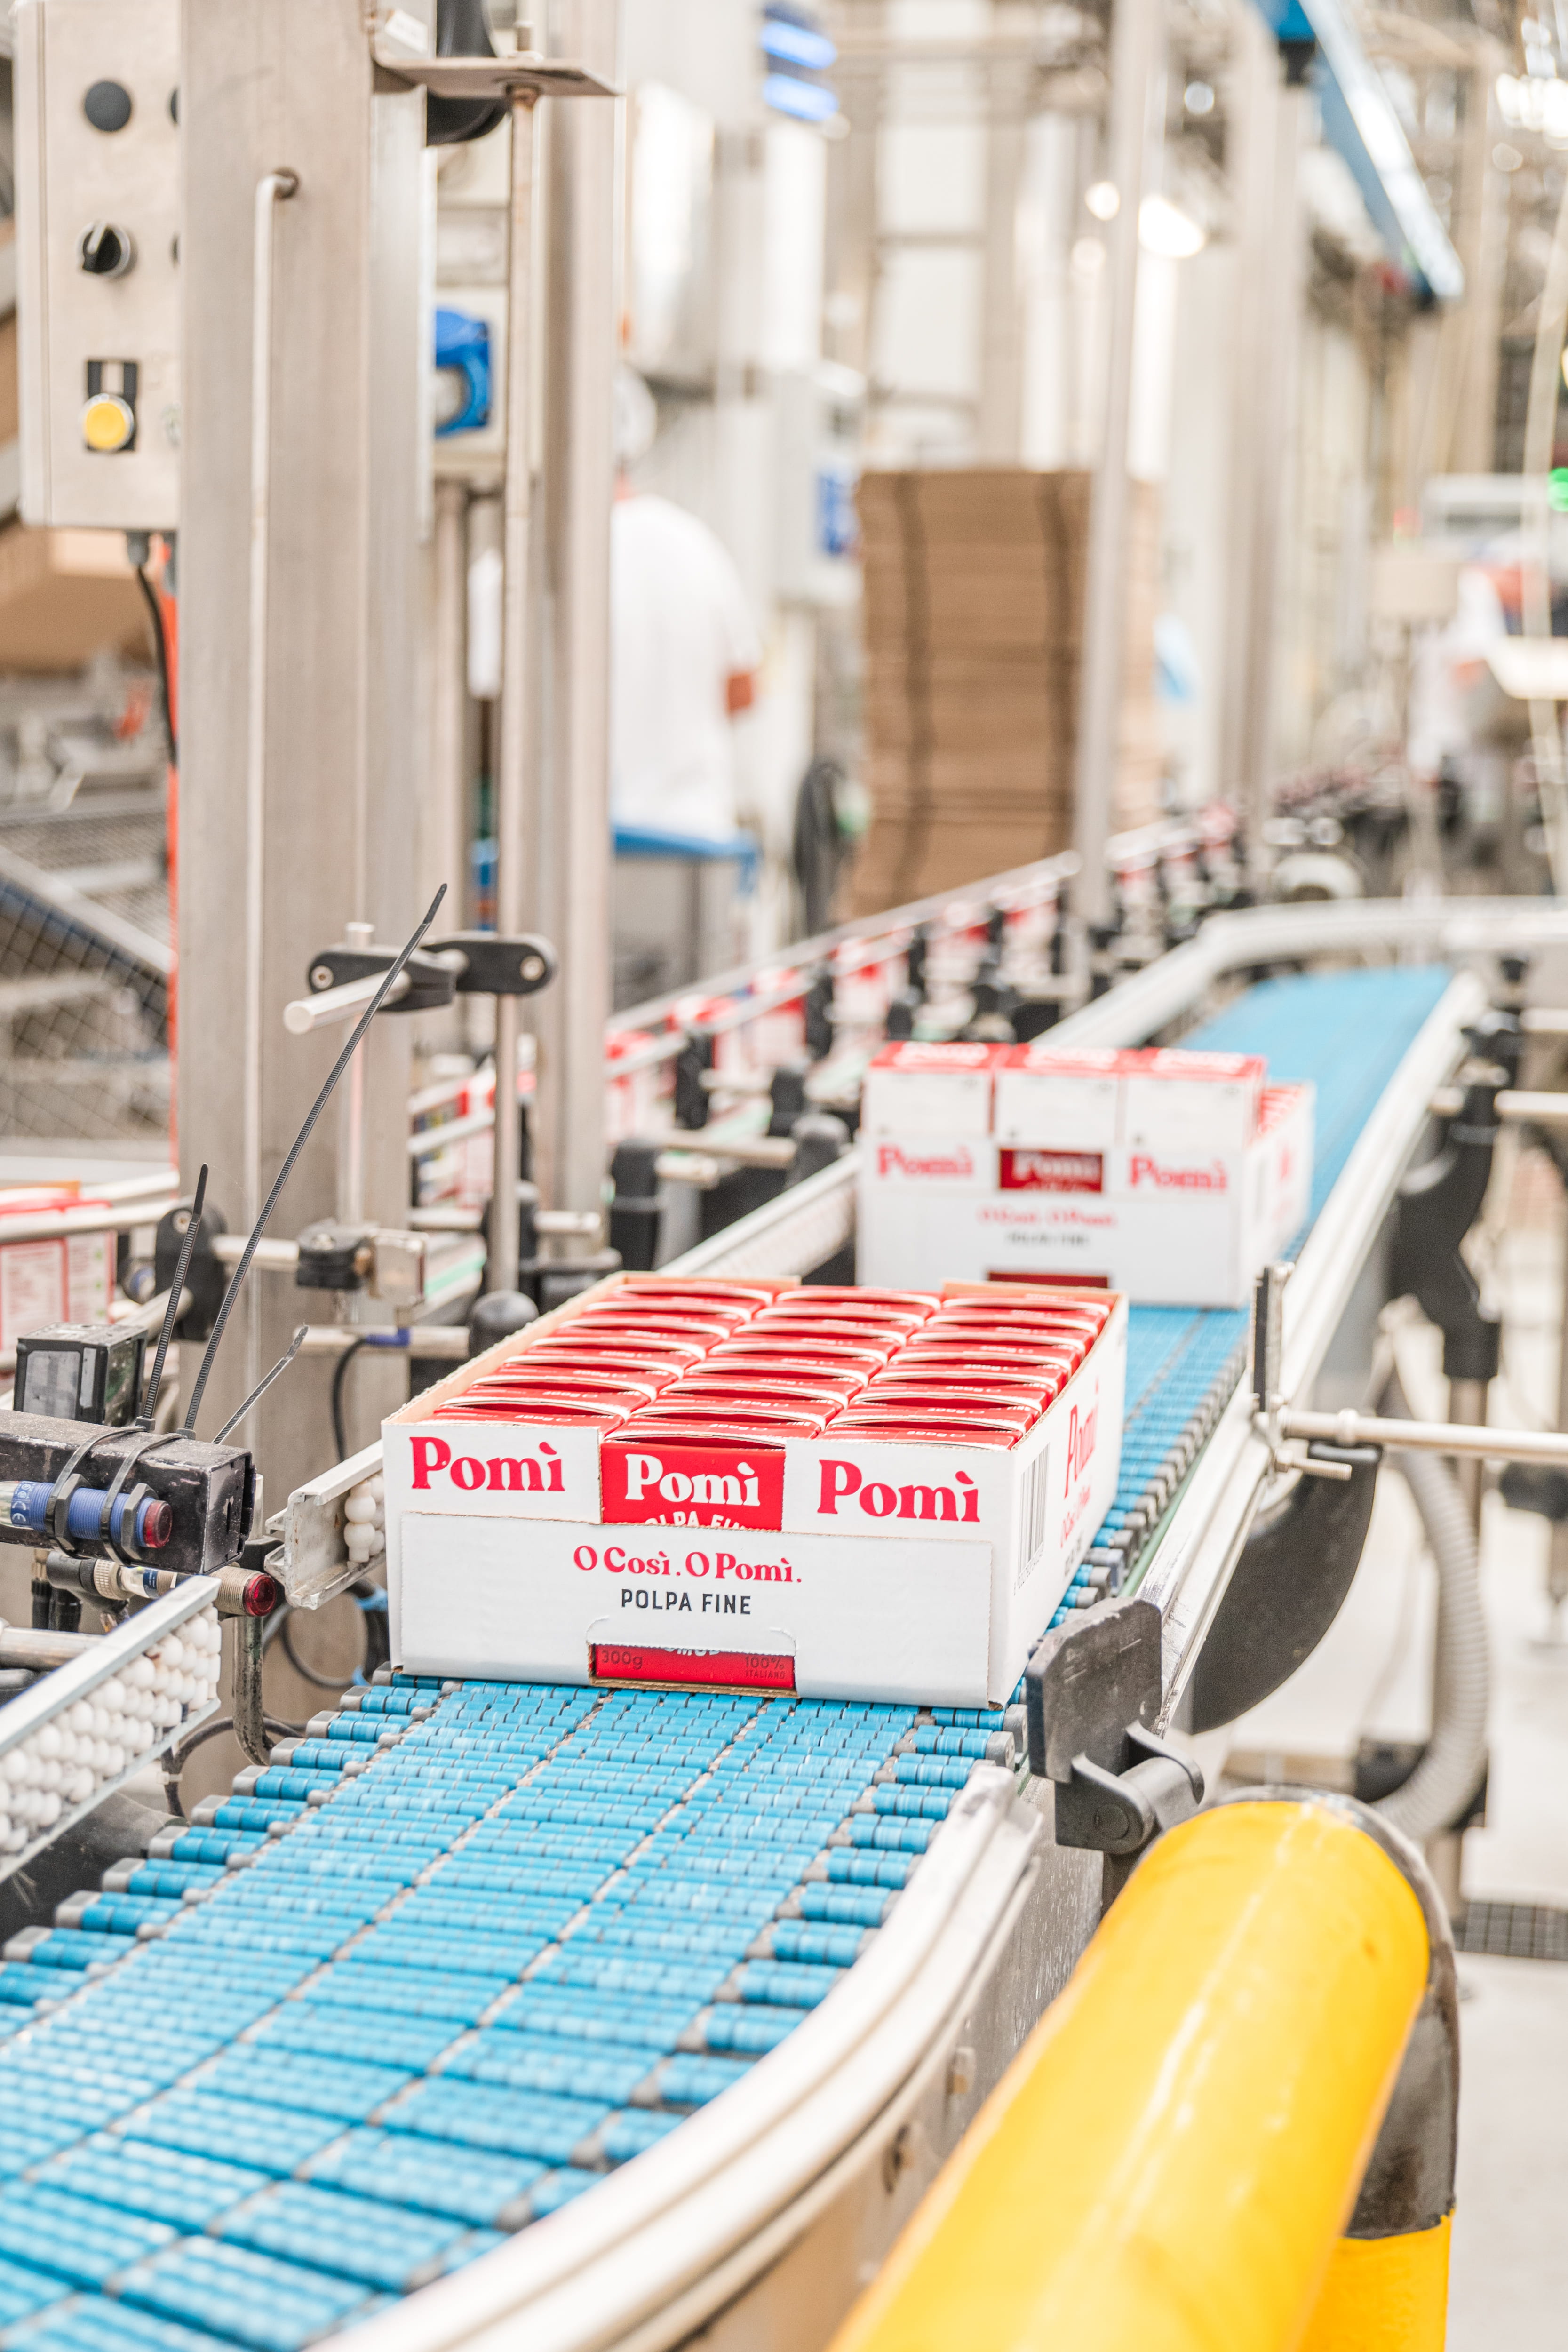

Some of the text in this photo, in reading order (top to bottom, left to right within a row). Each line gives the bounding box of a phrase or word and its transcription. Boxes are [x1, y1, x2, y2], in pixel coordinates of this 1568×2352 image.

[409, 1436, 565, 1492] Pomì
[625, 1453, 761, 1506] Pomì
[817, 1459, 980, 1523] Pomì
[621, 1589, 751, 1615] POLPA FINE
[601, 1650, 785, 1670] 300g 100%
[745, 1670, 786, 1680] ITALIANO
